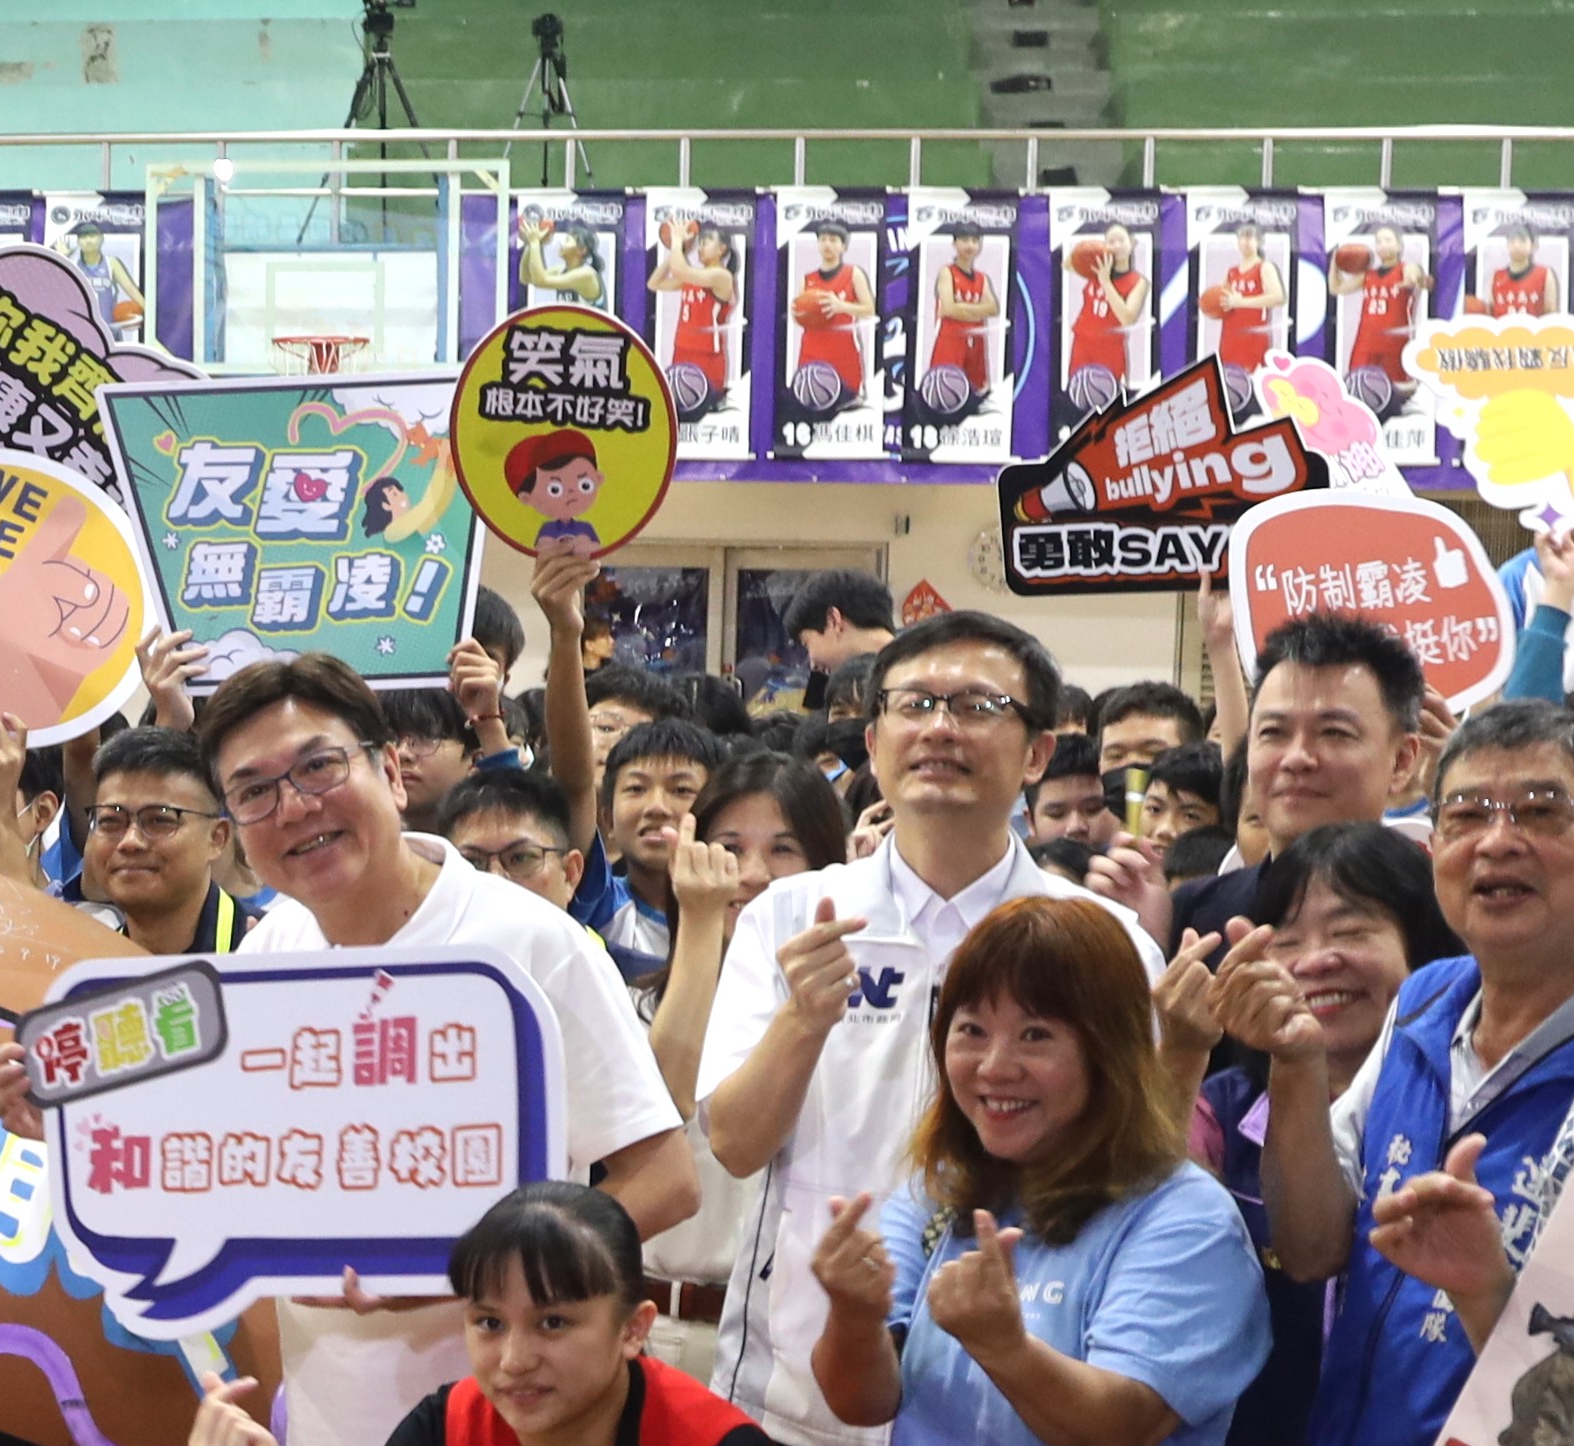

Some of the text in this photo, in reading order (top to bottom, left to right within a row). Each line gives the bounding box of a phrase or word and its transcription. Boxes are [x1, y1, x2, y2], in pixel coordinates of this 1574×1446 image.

[508, 330, 624, 389] 笑氣
[1114, 377, 1217, 469] 拒絕
[165, 437, 355, 536] 友愛
[1104, 434, 1298, 504] bullying
[242, 970, 477, 1090] 一起調出
[78, 1118, 504, 1196] 和諧的友善校園
